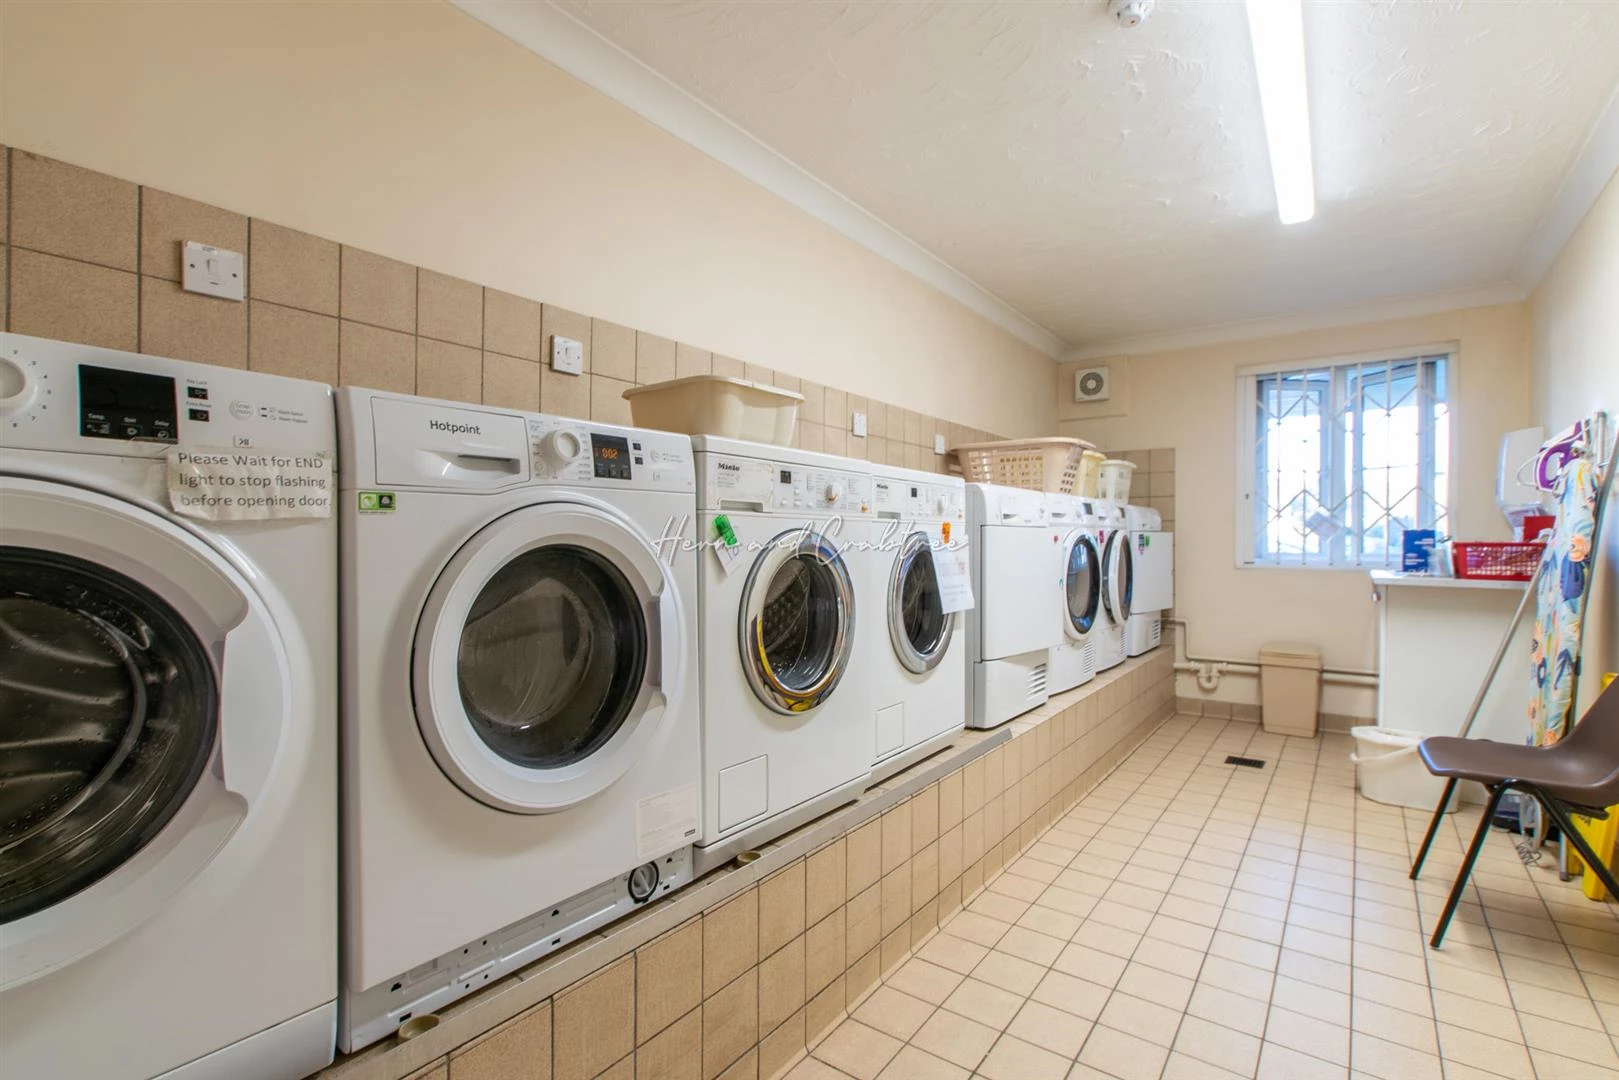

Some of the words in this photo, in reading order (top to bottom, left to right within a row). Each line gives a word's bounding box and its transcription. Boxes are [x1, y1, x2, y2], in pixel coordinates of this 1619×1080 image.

[429, 419, 482, 436] Hotpoint
[178, 452, 229, 466] Please
[232, 455, 269, 468] Wait
[271, 456, 291, 468] for
[294, 458, 323, 469] END
[717, 462, 740, 472] Miele
[179, 473, 214, 488] light
[219, 475, 235, 486] to
[239, 475, 272, 488] stop
[275, 475, 325, 489] flashing
[181, 494, 233, 507] before
[236, 496, 296, 509] opening
[298, 495, 332, 507] door.
